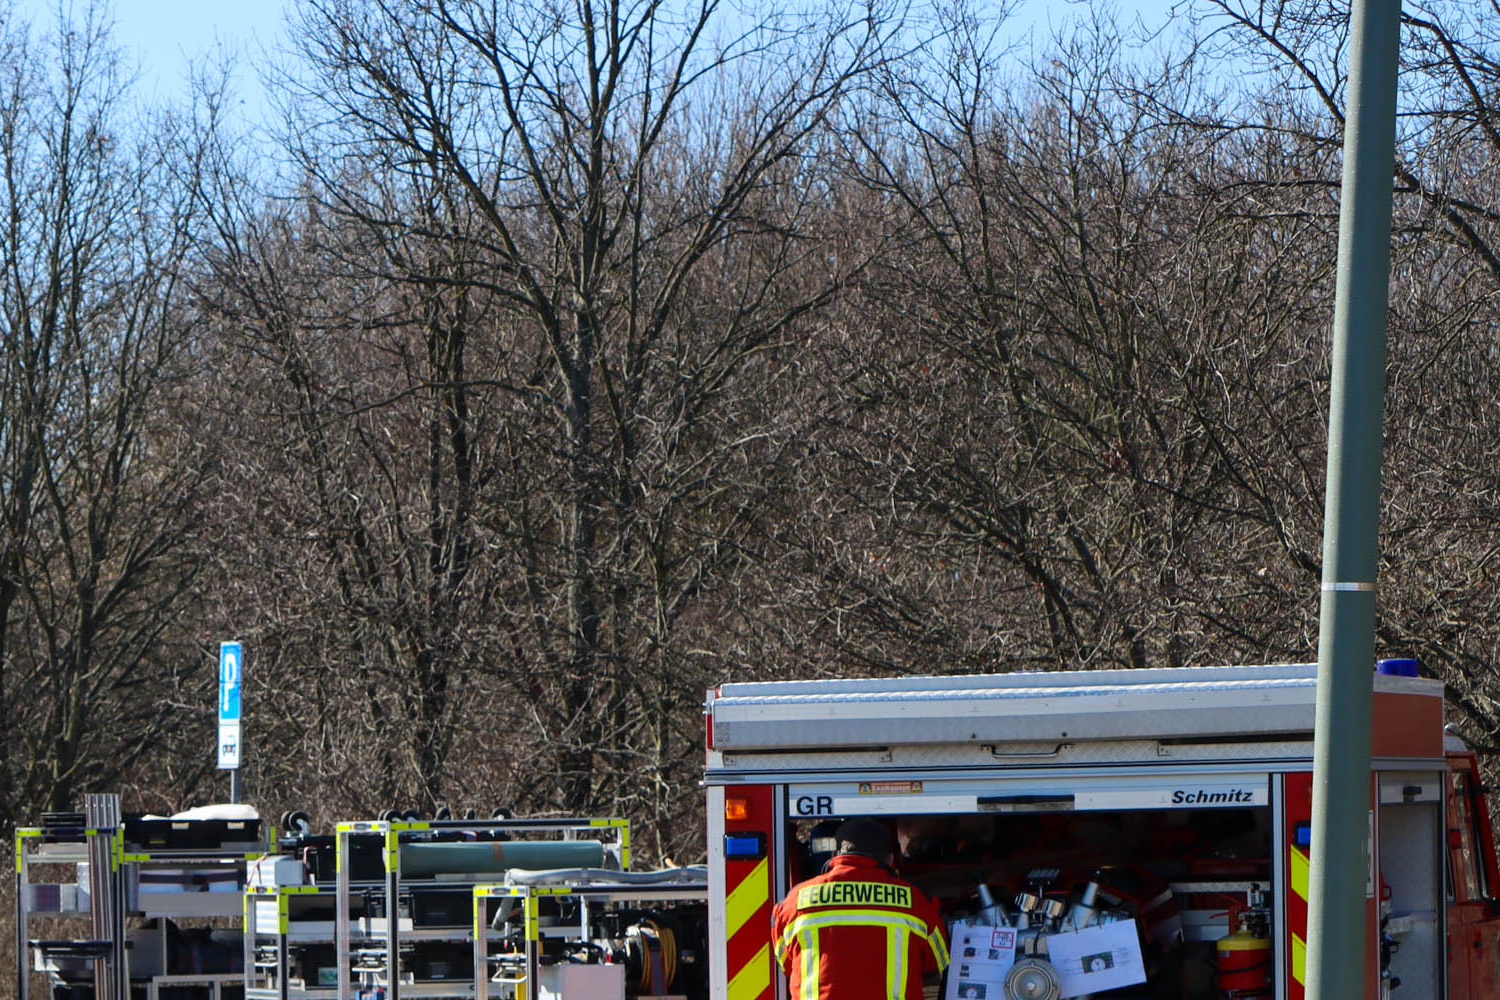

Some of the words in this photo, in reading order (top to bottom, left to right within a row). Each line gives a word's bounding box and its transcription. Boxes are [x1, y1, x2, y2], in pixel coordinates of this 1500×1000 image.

[223, 653, 237, 712] P
[796, 796, 833, 816] GR
[1172, 789, 1253, 804] Schmitz
[800, 884, 909, 906] FEUERWEHR
